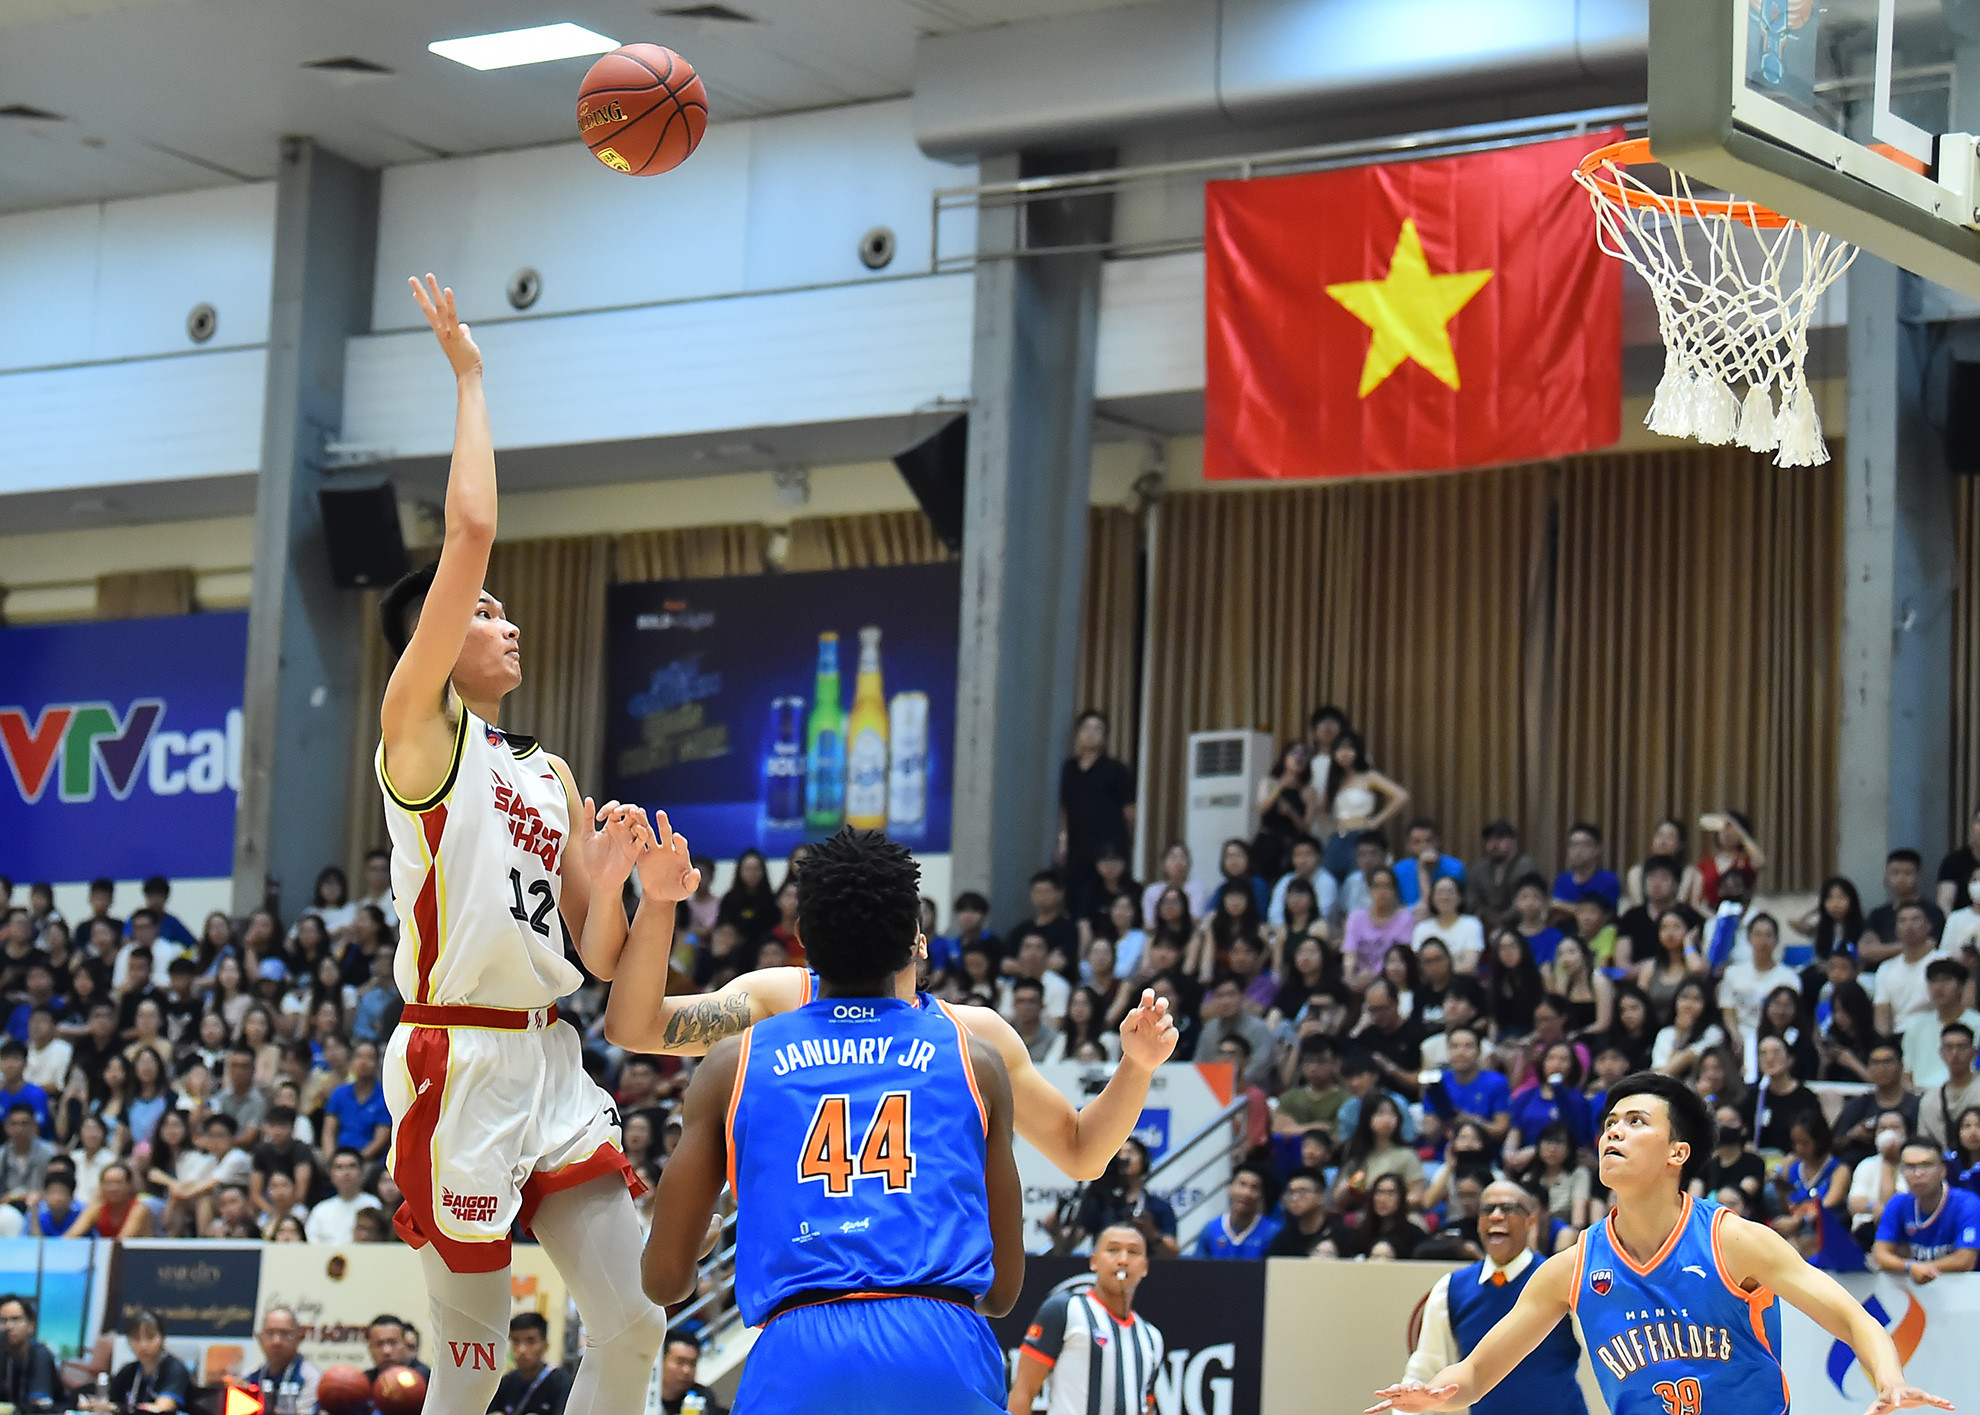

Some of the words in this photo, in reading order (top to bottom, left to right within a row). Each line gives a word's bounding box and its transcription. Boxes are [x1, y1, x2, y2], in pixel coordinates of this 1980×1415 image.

[509, 867, 556, 937] 12
[833, 1005, 875, 1019] OCH
[773, 1036, 894, 1076] JANUARY
[898, 1038, 937, 1073] JR
[797, 1090, 917, 1197] 44
[442, 1193, 498, 1209] SAIGON
[450, 1207, 497, 1222] HEAT
[1592, 1271, 1611, 1281] VBA
[448, 1341, 497, 1371] VN
[1652, 1376, 1702, 1415] 39
